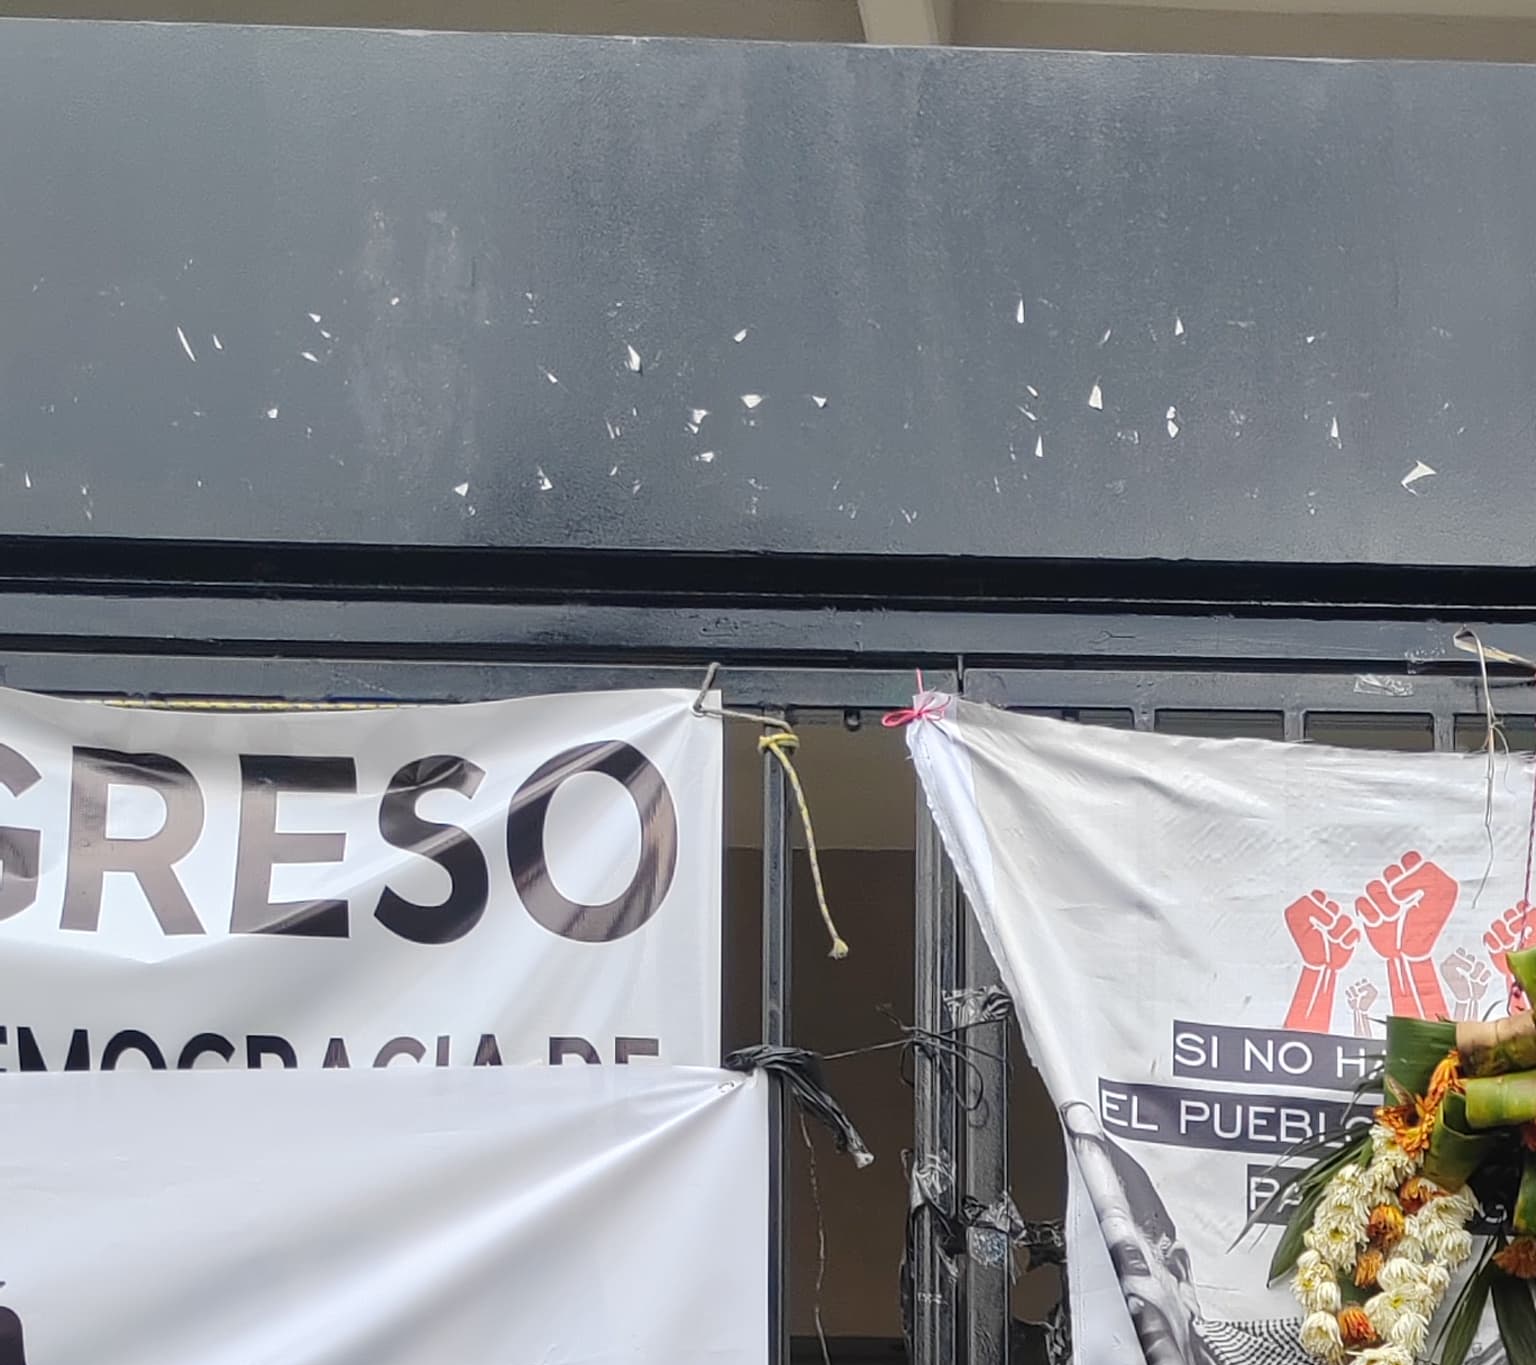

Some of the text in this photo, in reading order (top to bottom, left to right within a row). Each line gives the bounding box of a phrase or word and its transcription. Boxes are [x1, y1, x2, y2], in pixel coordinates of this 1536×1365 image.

[1174, 1032, 1219, 1068] SI
[1243, 1039, 1314, 1075] NO
[1099, 1088, 1159, 1132] EL
